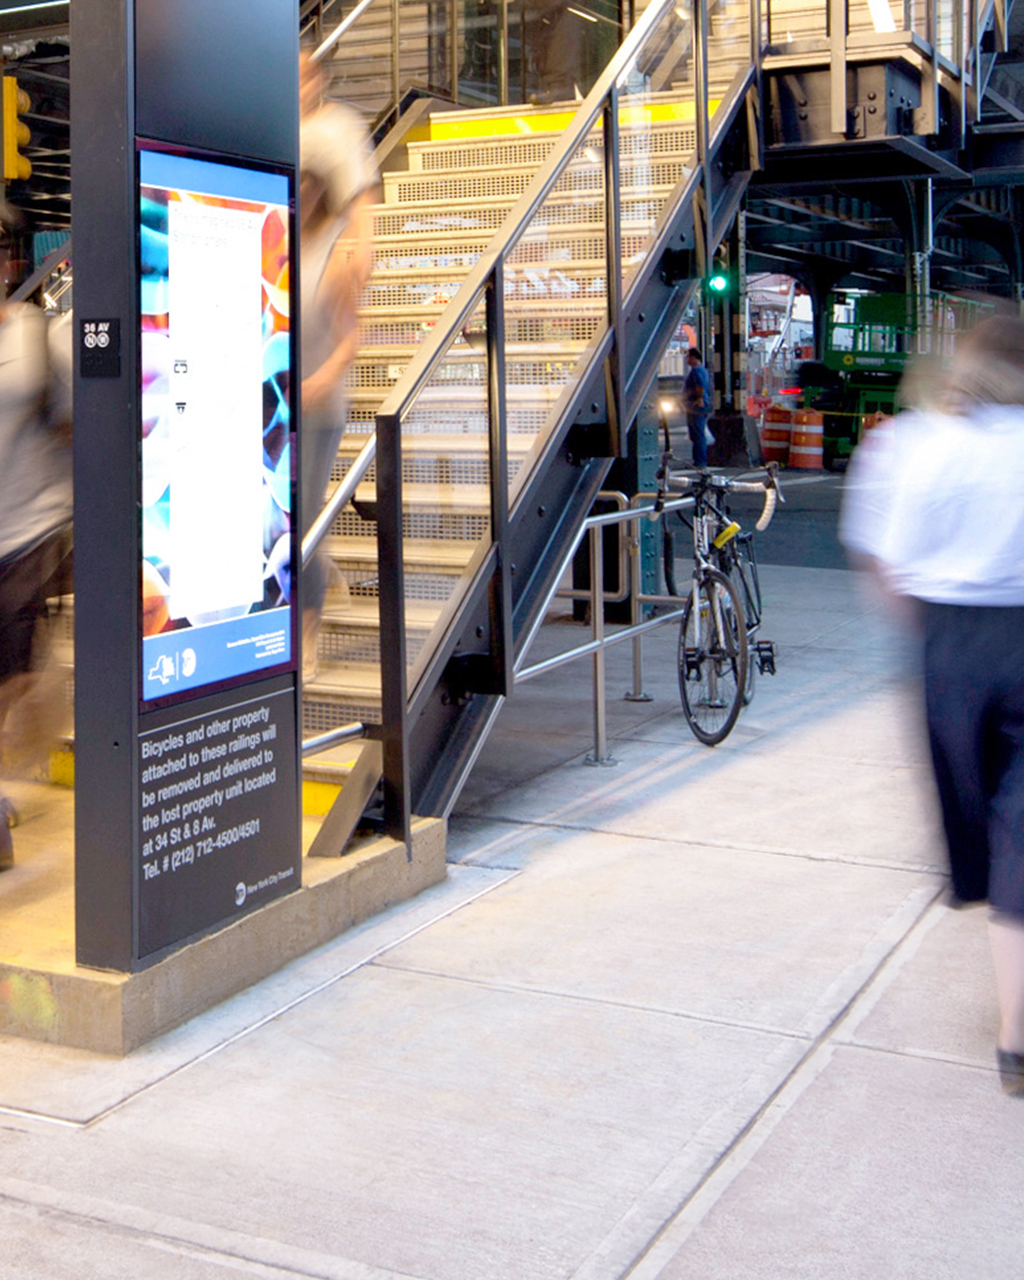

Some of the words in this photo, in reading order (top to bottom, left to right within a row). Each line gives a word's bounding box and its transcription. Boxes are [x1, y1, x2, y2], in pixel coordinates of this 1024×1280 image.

[84, 322, 96, 333] 36
[142, 734, 184, 759] Bicycles
[186, 725, 204, 744] and
[206, 718, 231, 738] other
[232, 706, 270, 732] property
[142, 754, 187, 783] attached
[189, 752, 199, 767] to
[201, 744, 227, 763] these
[228, 732, 261, 754] railings
[262, 724, 276, 742] will
[142, 792, 155, 808] be
[157, 772, 201, 802] removed
[203, 766, 221, 786] and
[222, 753, 263, 778] delivered
[264, 749, 273, 763] to
[142, 815, 159, 832] the
[161, 804, 180, 825] lost
[182, 789, 224, 820] property
[226, 781, 243, 800] unit
[244, 768, 276, 793] located
[142, 838, 153, 856] at
[155, 832, 168, 851] 34
[170, 827, 181, 845] St
[183, 823, 191, 839] &
[192, 819, 200, 835] 8
[201, 816, 216, 833] Av.
[142, 860, 160, 881] Tel.
[163, 855, 169, 872] #
[171, 844, 195, 871] (212)
[196, 818, 260, 857] 712-4500/4501
[258, 878, 269, 889] York
[269, 875, 278, 885] City
